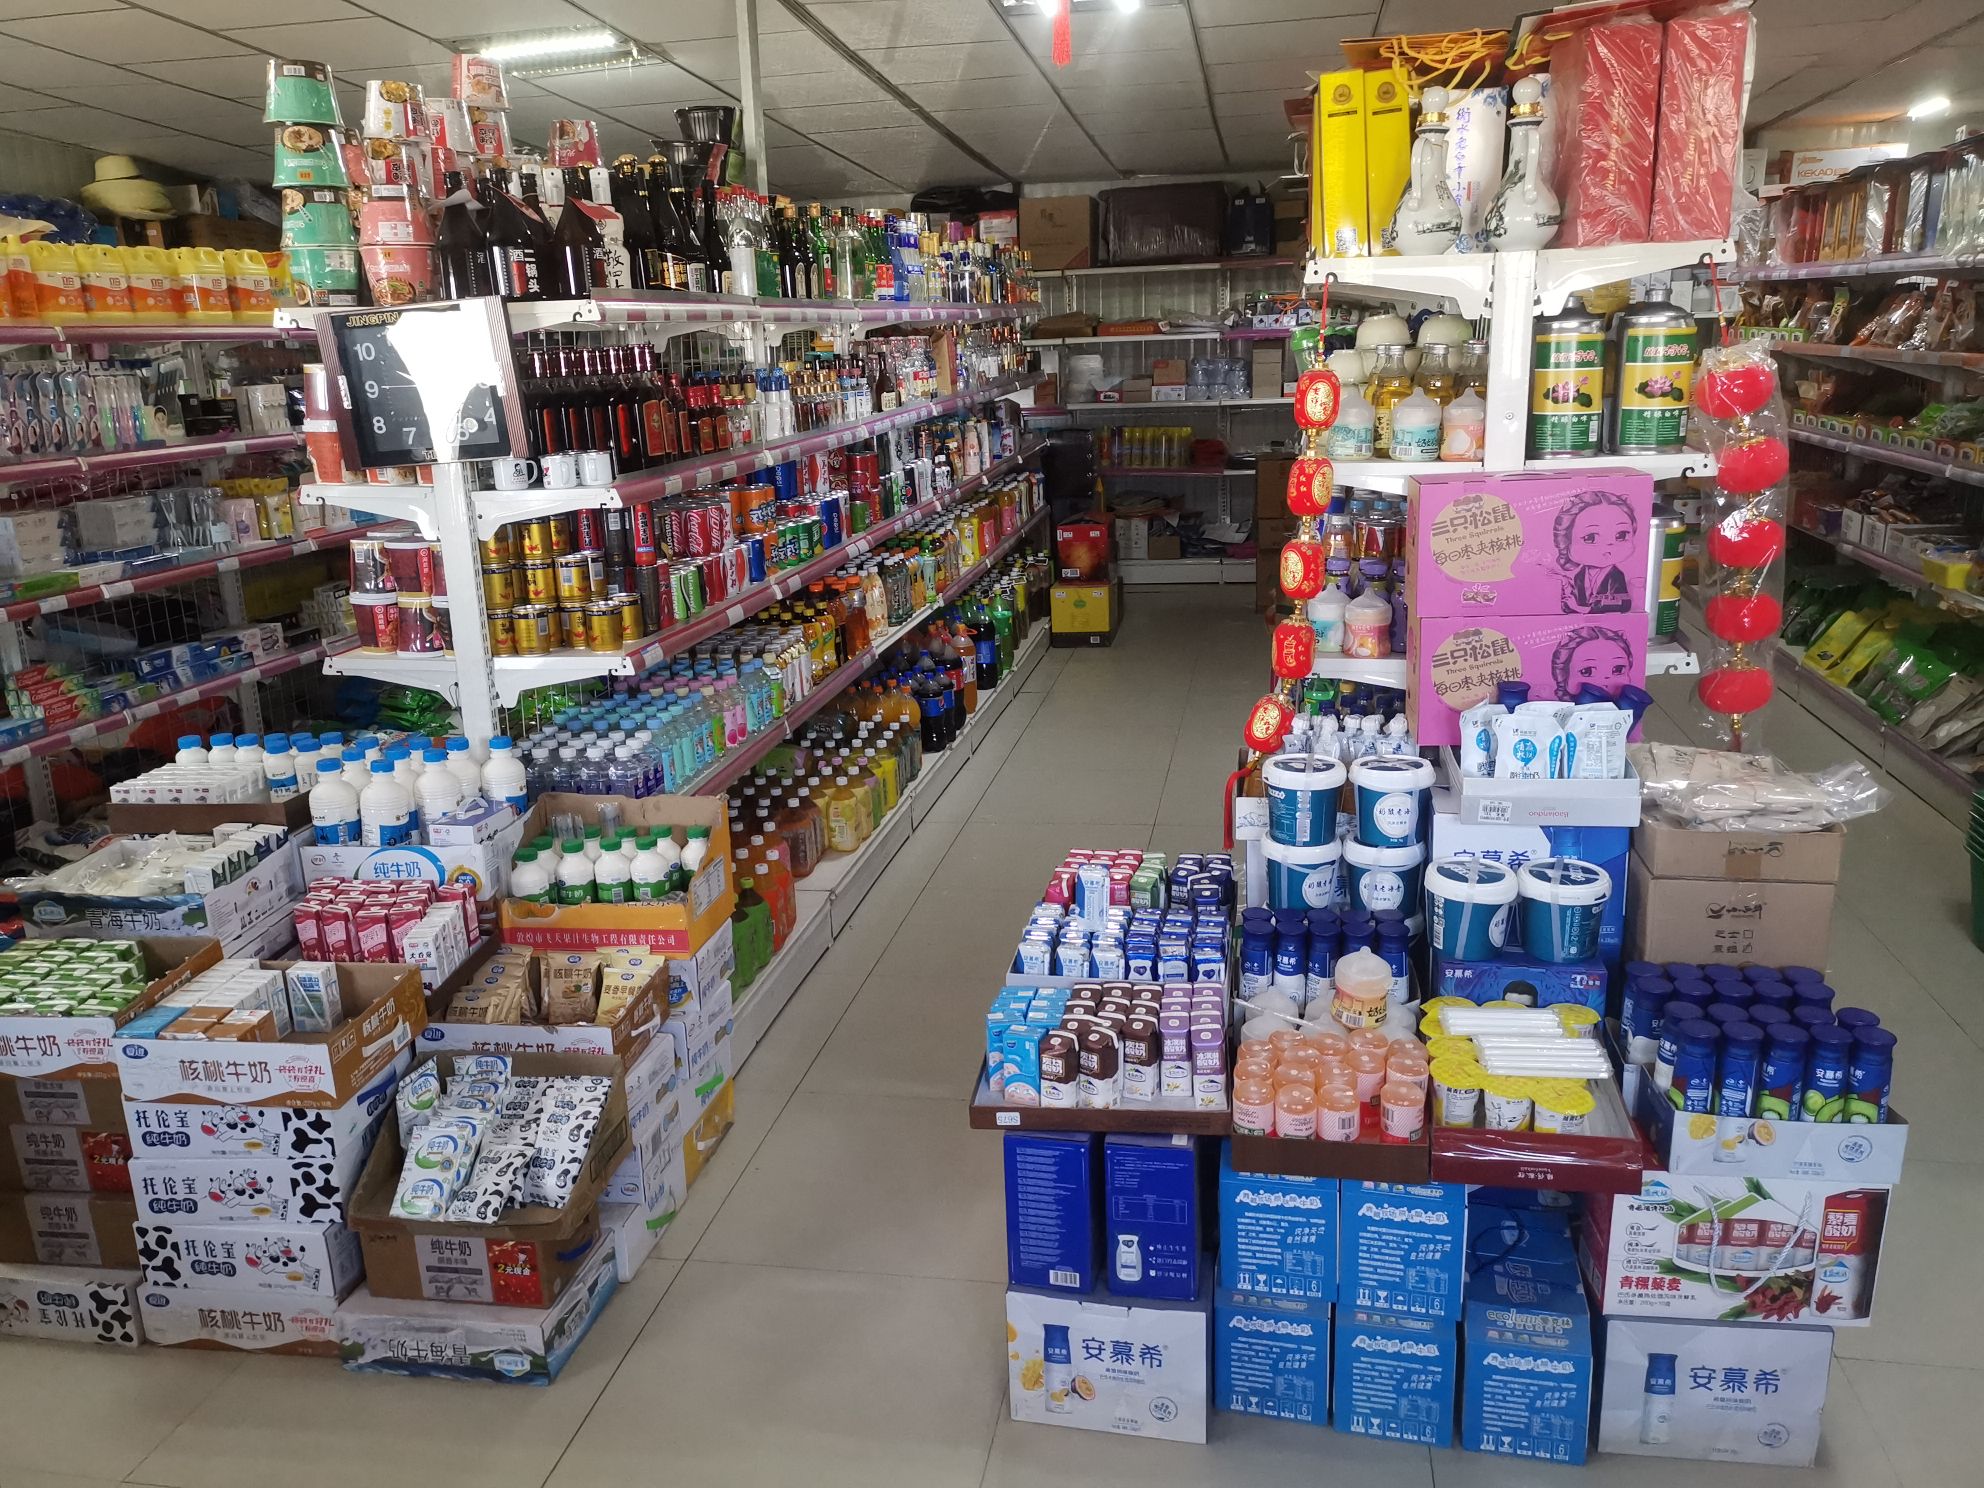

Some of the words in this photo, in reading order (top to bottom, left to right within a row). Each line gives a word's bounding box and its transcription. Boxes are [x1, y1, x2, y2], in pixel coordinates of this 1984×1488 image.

[510, 250, 524, 261] 酒
[346, 312, 399, 327] JINGPIN
[353, 343, 375, 361] 10
[365, 381, 379, 399] 9
[484, 408, 496, 424] 4
[373, 416, 386, 434] 8
[403, 428, 417, 445] 7
[1431, 504, 1516, 537] 三只松鼠
[1446, 534, 1467, 545] Three
[1431, 638, 1514, 668] 三只松鼠
[1446, 665, 1467, 676] Three
[374, 861, 422, 878] 纯牛奶
[86, 909, 160, 931] 青海牛奶
[422, 1028, 444, 1040] 夏进
[179, 1058, 272, 1084] 核桃牛奶
[476, 1059, 500, 1070] 纯牛奶
[1815, 1068, 1843, 1081] 安慕希
[136, 1109, 191, 1129] 托伦宝
[26, 1132, 66, 1149] 纯牛奶
[144, 1132, 188, 1146] 纯牛奶
[427, 1139, 450, 1151] 纯牛奶
[143, 1176, 198, 1196] 托伦宝
[410, 1184, 434, 1197] 纯牛奶
[40, 1206, 78, 1223] 纯牛奶
[152, 1199, 195, 1213] 纯牛奶
[184, 1239, 236, 1259] 托伦宝
[430, 1238, 472, 1258] 纯牛奶
[193, 1261, 234, 1276] 纯牛奶
[497, 1263, 532, 1276] 2元现金
[199, 1309, 285, 1333] 核桃牛奶
[1081, 1337, 1163, 1369] 安慕希
[1689, 1365, 1781, 1395] 安慕希
